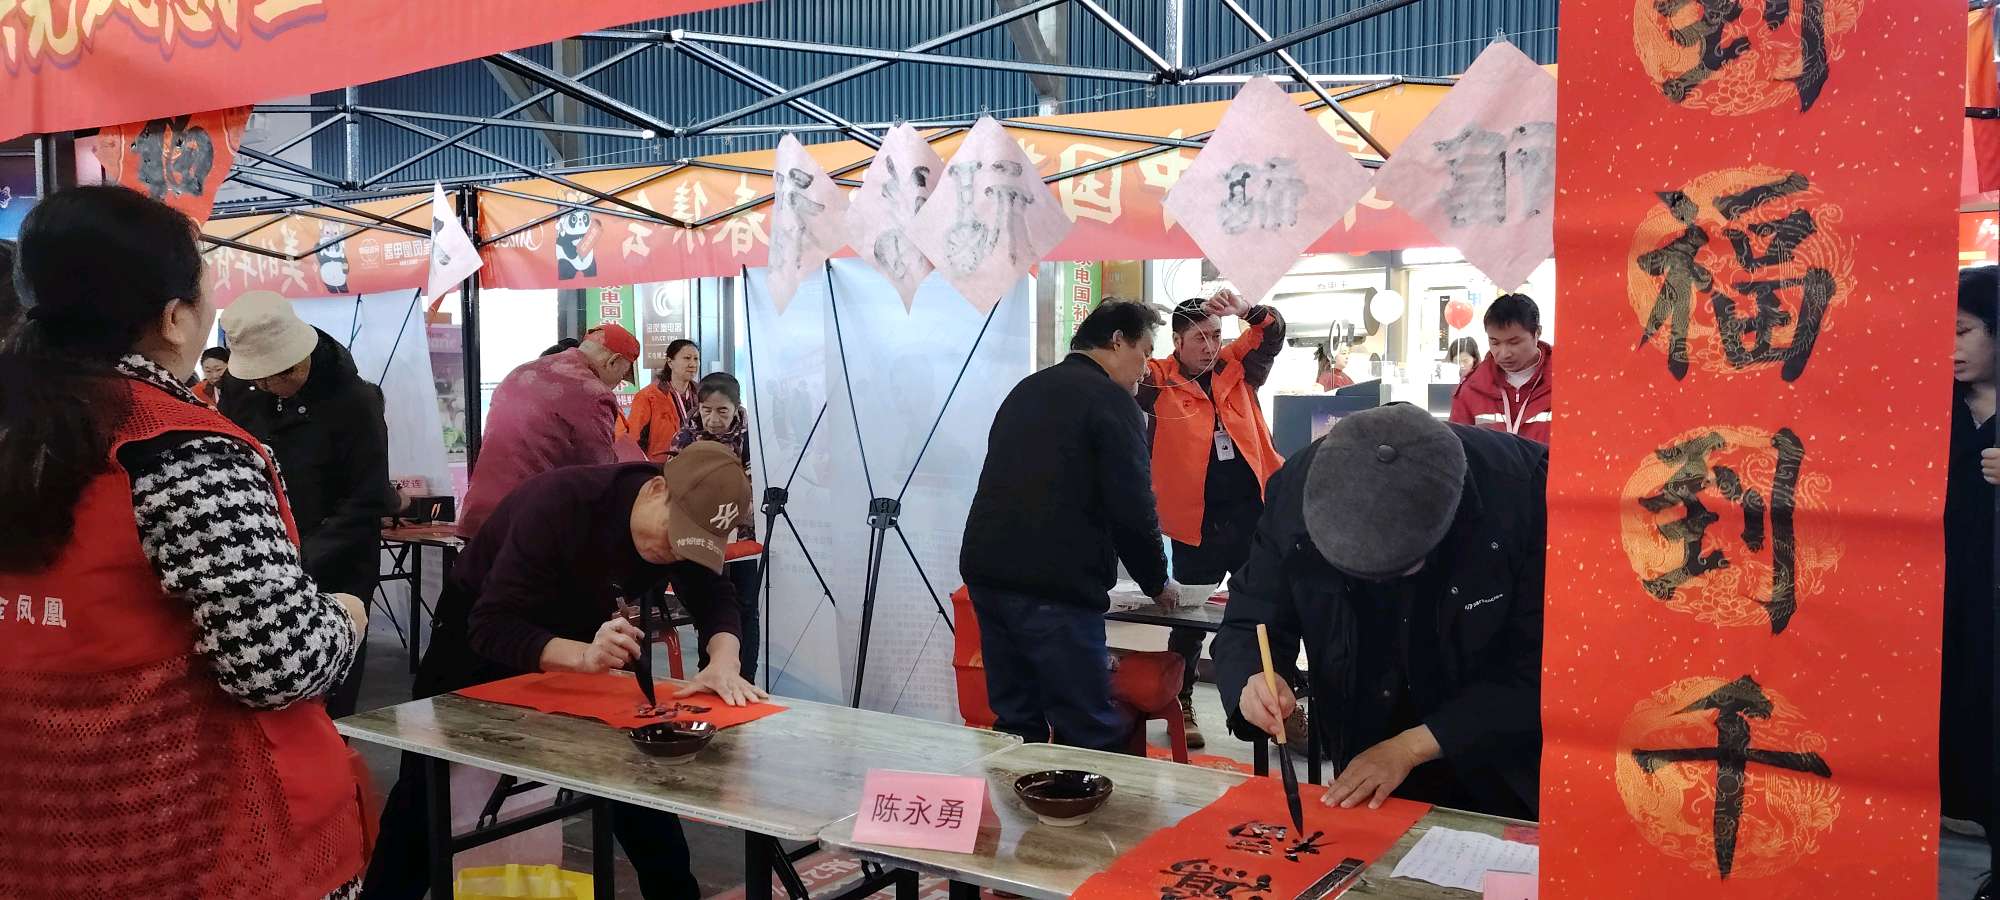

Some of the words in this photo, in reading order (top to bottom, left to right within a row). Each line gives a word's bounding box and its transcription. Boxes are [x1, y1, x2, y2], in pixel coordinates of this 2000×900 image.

[1073, 259, 1092, 334] 电国补
[871, 793, 966, 831] 陈永勇
